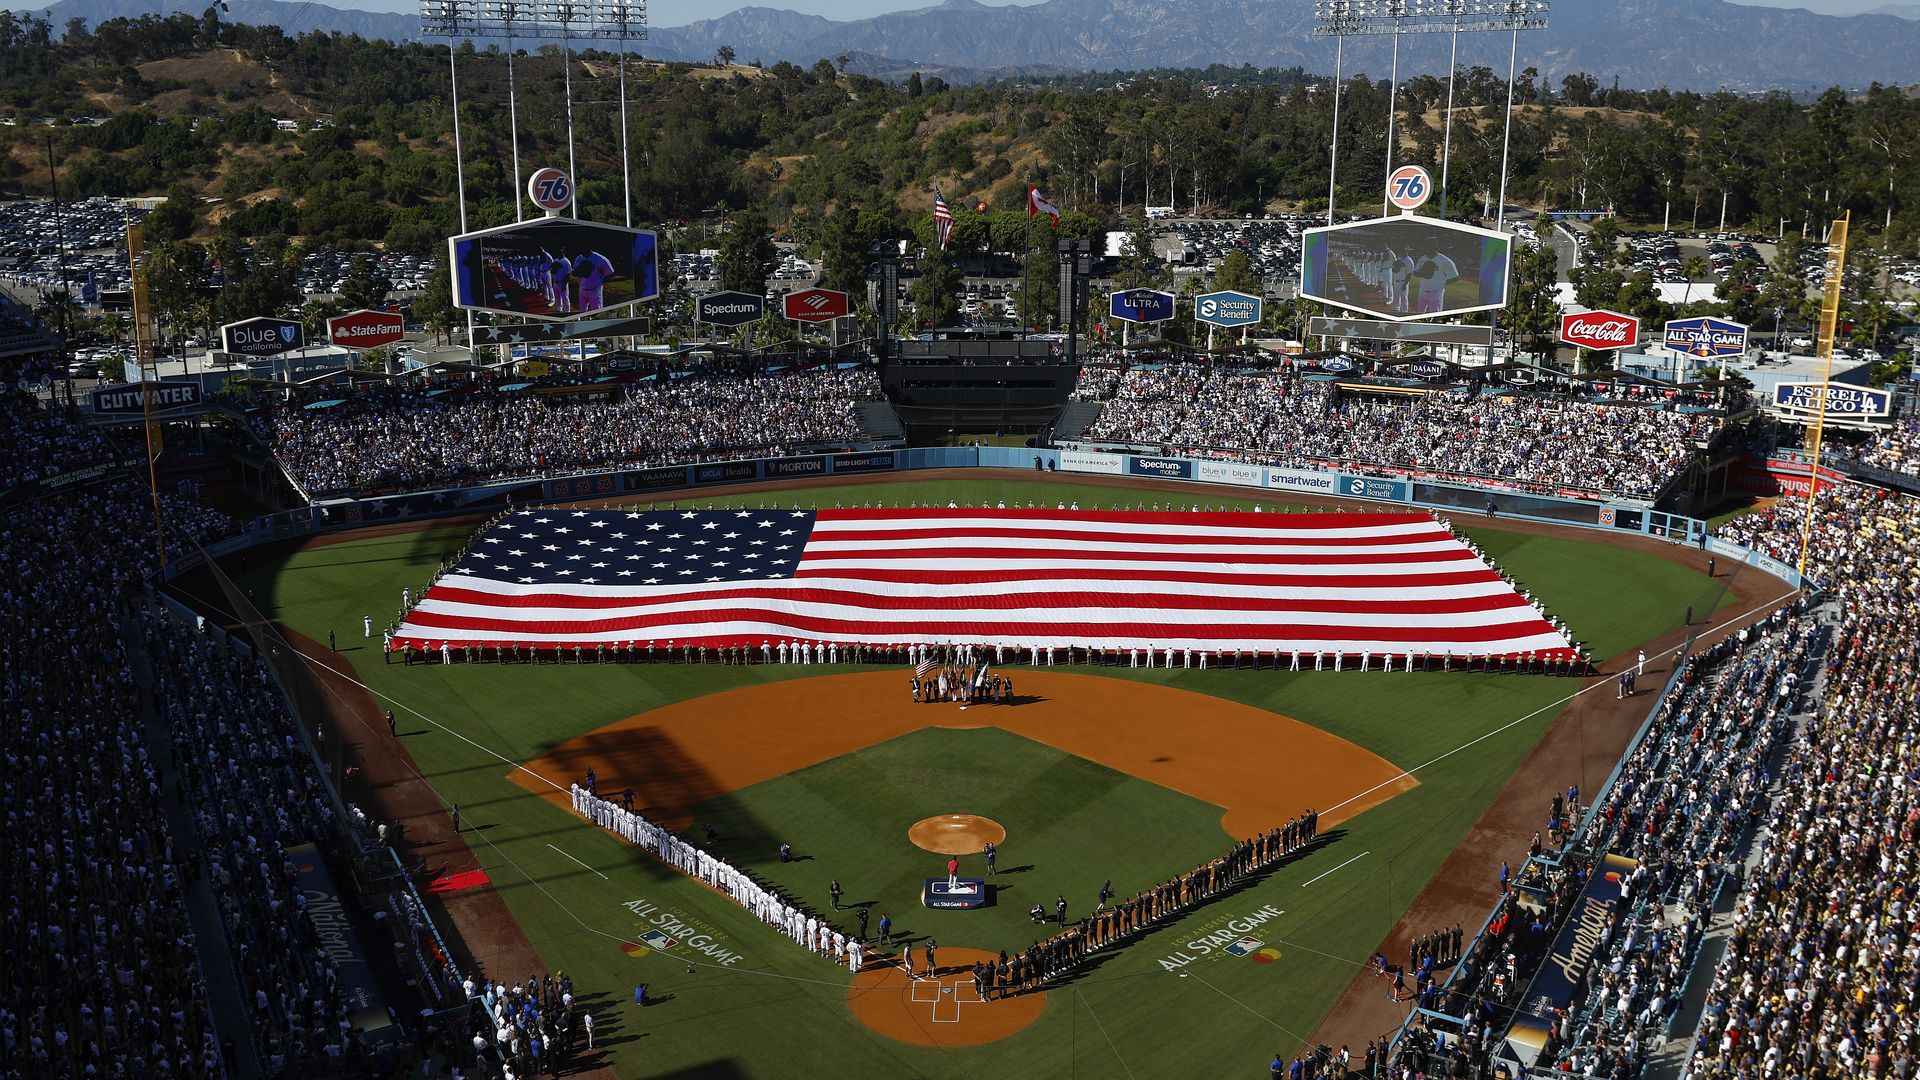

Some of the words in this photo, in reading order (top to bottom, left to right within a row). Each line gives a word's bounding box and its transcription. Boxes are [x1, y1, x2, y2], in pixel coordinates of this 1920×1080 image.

[539, 177, 569, 201] 76
[1393, 175, 1424, 199] 76
[704, 303, 755, 316] Spectrum
[1124, 299, 1160, 308] ULTRA
[1220, 300, 1255, 311] Security
[1220, 310, 1250, 319] Benefit
[233, 328, 276, 344] blue
[1567, 319, 1631, 342] Coca-Cola
[1668, 331, 1684, 341] ALL
[1688, 332, 1711, 343] STAR
[1712, 333, 1743, 345] GAME
[241, 342, 282, 352] california
[1323, 358, 1335, 367] JIM
[100, 386, 194, 409] CUTWATER
[1783, 395, 1856, 411] JALISCO
[779, 461, 821, 472] MORTON
[870, 457, 892, 466] SELTZER
[1140, 459, 1179, 470] Spectrum
[725, 466, 751, 476] Health
[1232, 469, 1249, 477] blue
[1271, 474, 1331, 488] smartwater
[1367, 480, 1395, 491] Security
[1367, 488, 1391, 498] Benefit
[1601, 512, 1614, 521] 76
[670, 906, 687, 916] LOS
[688, 917, 728, 940] ANGELES
[622, 899, 658, 918] ALL
[650, 913, 695, 939] STAR
[687, 935, 744, 967] GAME
[1171, 934, 1192, 947] LOS
[1194, 913, 1234, 936] ANGELES
[1157, 951, 1197, 972] ALL
[1187, 929, 1239, 955] STAR
[1228, 904, 1285, 933] GAME
[1551, 897, 1617, 984] American
